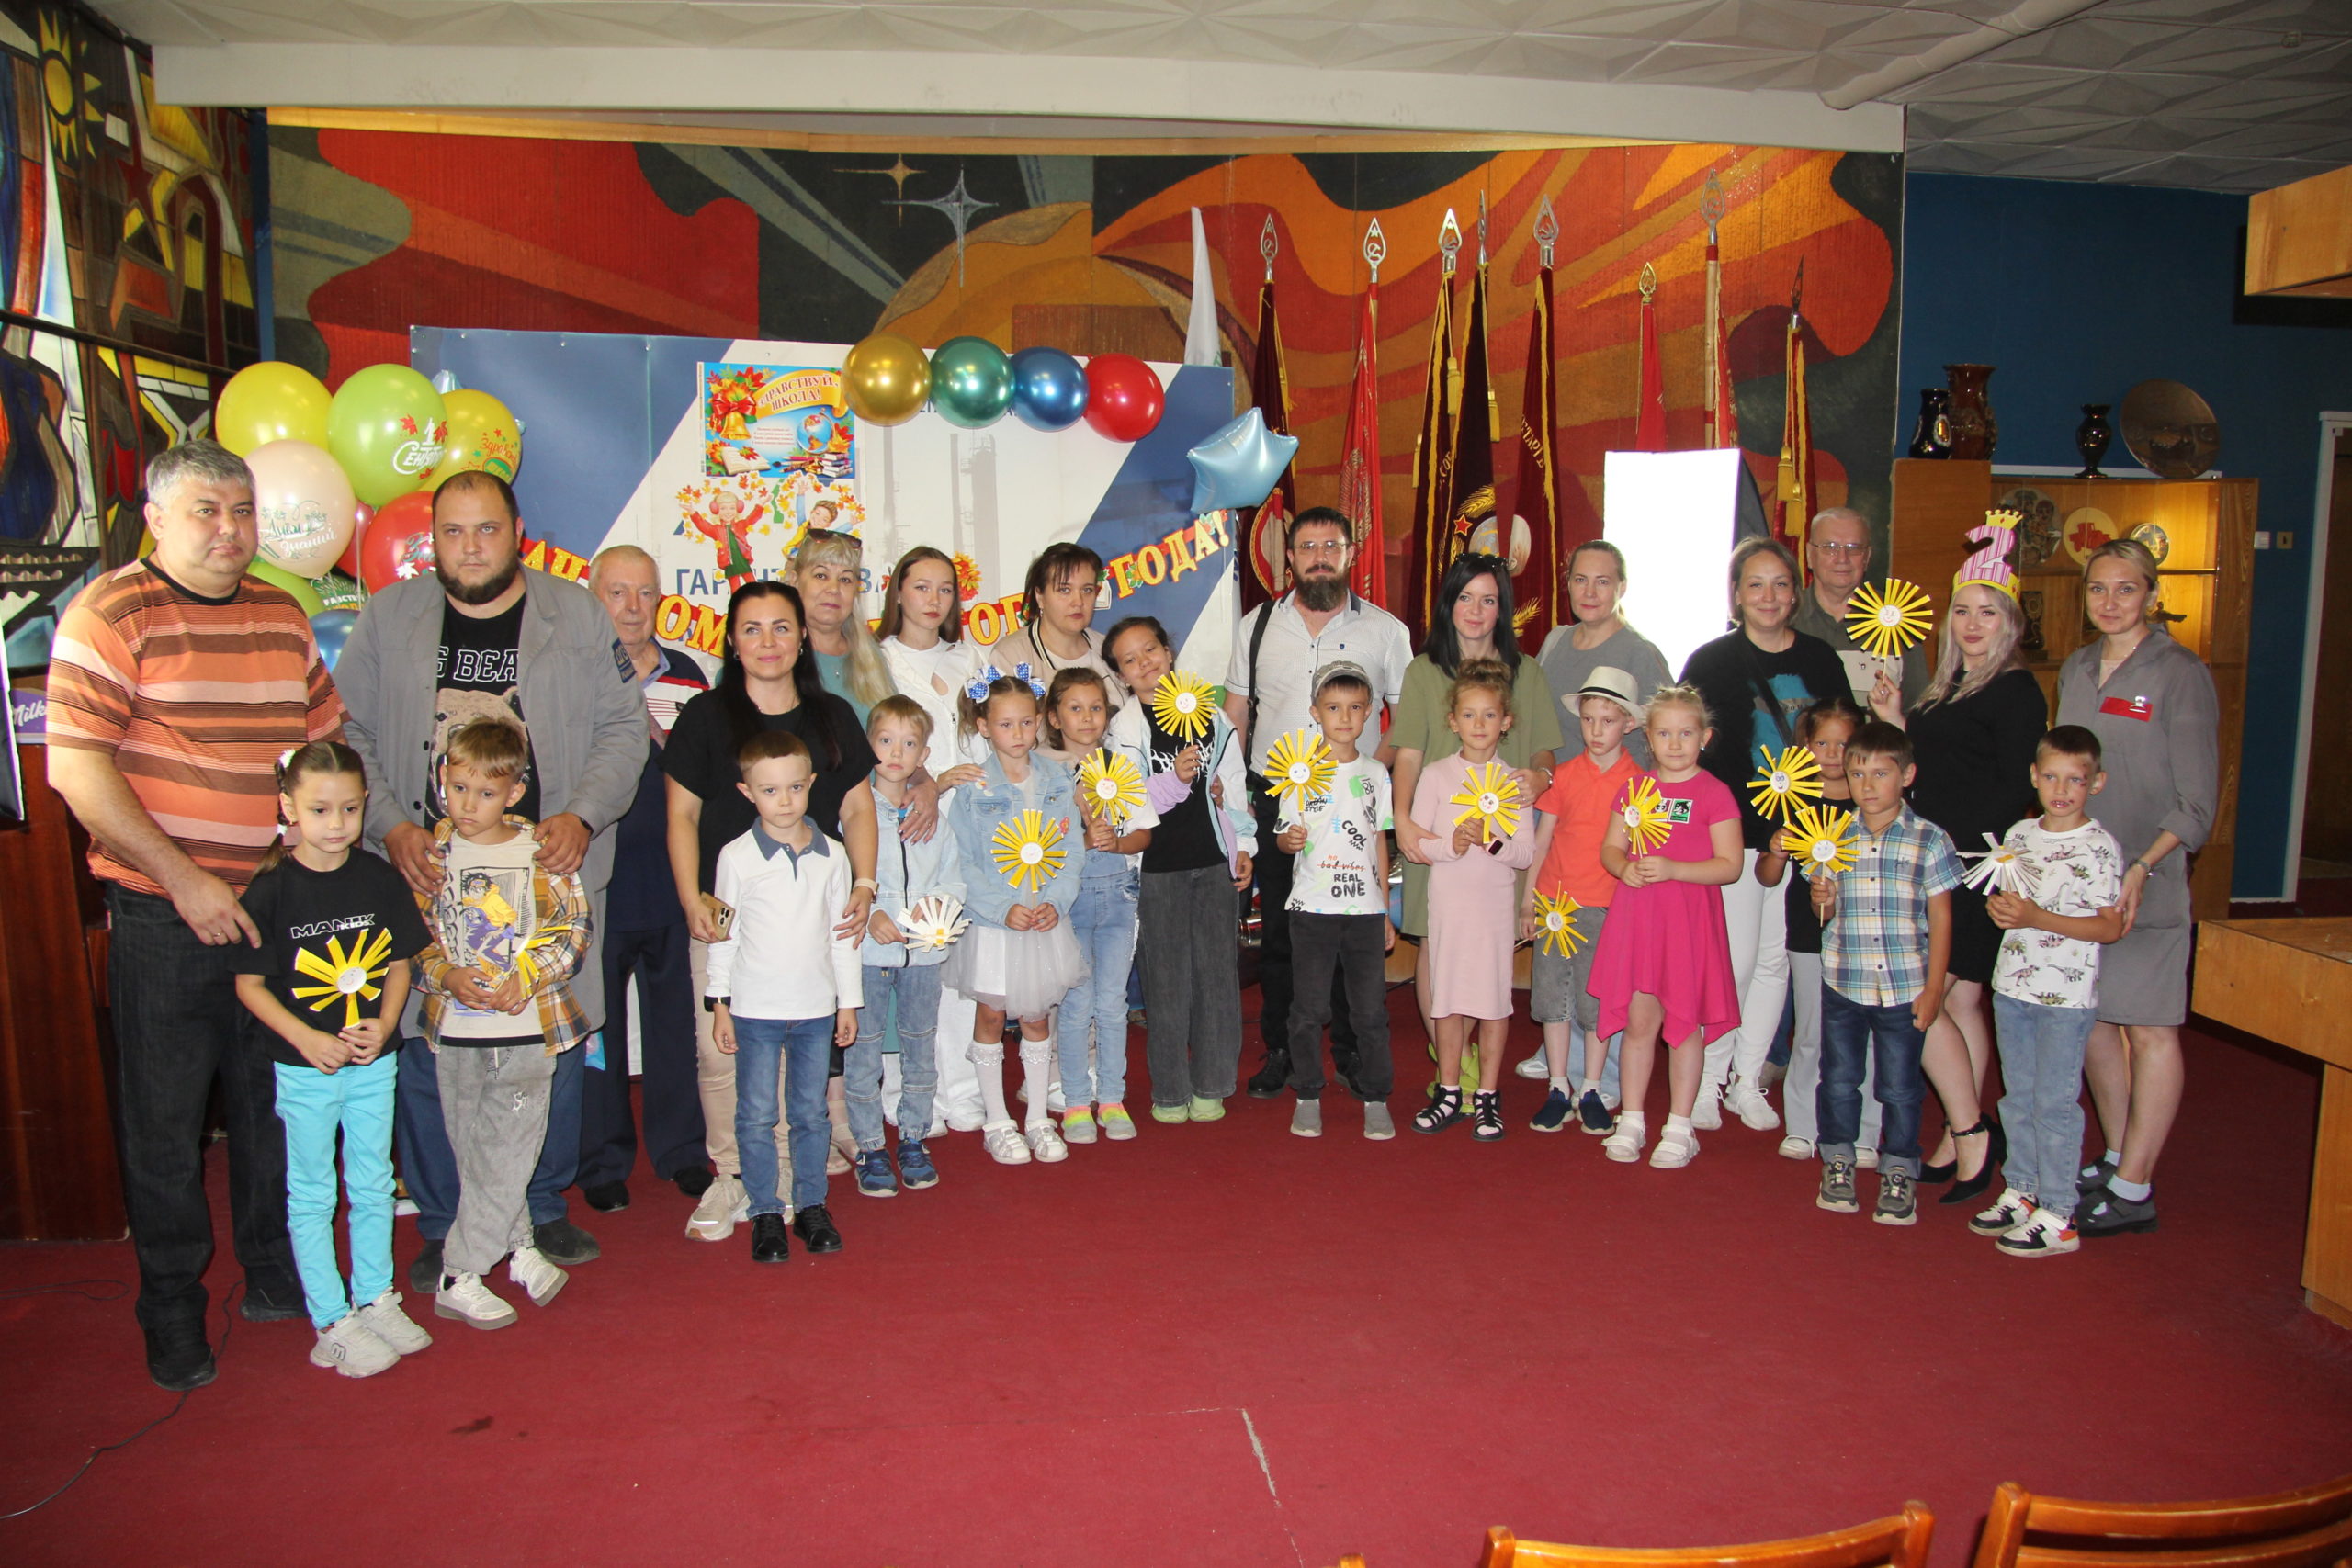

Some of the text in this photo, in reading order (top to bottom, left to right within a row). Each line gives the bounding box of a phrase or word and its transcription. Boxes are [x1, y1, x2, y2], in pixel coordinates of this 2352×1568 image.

[772, 389, 821, 412] ШКОЛА!
[1109, 510, 1230, 599] ГОДА!
[453, 649, 519, 682] BEA
[12, 699, 47, 727] Milk
[1341, 820, 1367, 847] COOL
[1330, 881, 1366, 898] ONE
[1333, 872, 1363, 883] REAL
